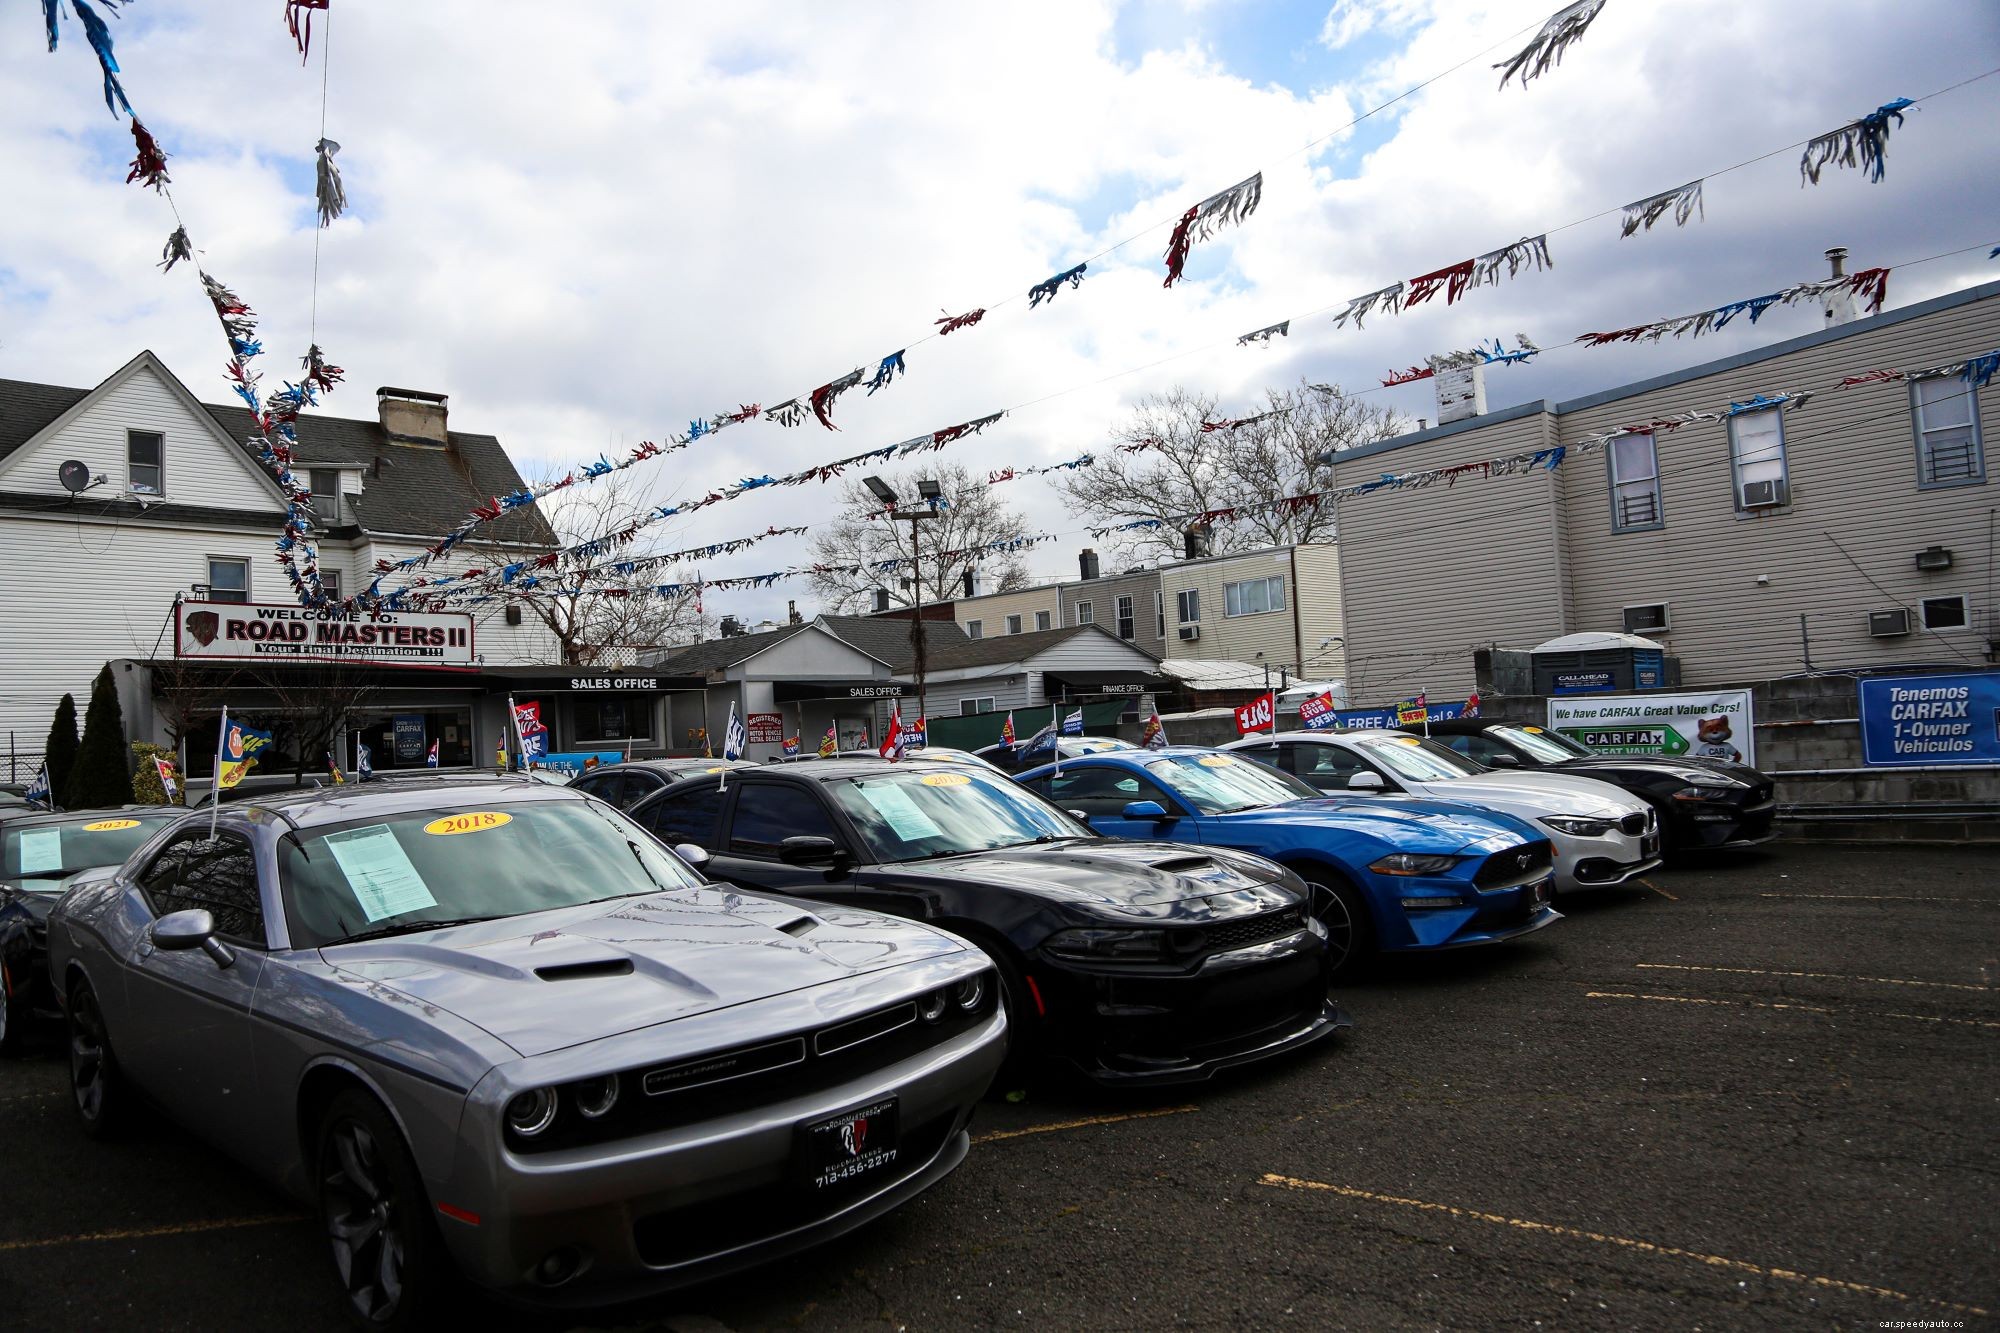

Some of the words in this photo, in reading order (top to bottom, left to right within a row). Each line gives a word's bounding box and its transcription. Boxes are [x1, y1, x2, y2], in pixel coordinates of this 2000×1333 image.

[257, 608, 360, 622] WELCOME
[367, 613, 398, 623] TO:
[226, 618, 308, 641] ROAD
[316, 622, 446, 647] MASTERS
[448, 627, 466, 648] II
[260, 643, 295, 653] Your
[300, 644, 335, 654] Final
[342, 645, 421, 656] Destination
[1558, 673, 1609, 681] CALLAHEAD
[571, 678, 611, 689] SALES
[614, 678, 657, 689] OFFICE
[1102, 685, 1126, 693] FINANCE
[1126, 684, 1144, 692] OFFICE
[850, 688, 875, 697] SALES
[876, 686, 901, 696] OFFICE
[1890, 687, 1969, 702] Tenemos
[1556, 709, 1571, 720] We
[1573, 708, 1597, 719] have
[1600, 707, 1641, 718] CARFAX
[1644, 705, 1674, 717] Great
[1676, 703, 1708, 715] Value
[1711, 701, 1740, 714] Cars!
[1891, 701, 1969, 720] CARFAX
[749, 715, 782, 726] REGISTERED
[1348, 717, 1383, 728] FREE
[396, 725, 422, 733] CARFAX
[1893, 721, 1971, 738] 1-Owner
[1586, 731, 1663, 745] CARFAX
[1709, 747, 1725, 756] CAR
[95, 820, 131, 830] 2021
[442, 813, 497, 833] 2018
